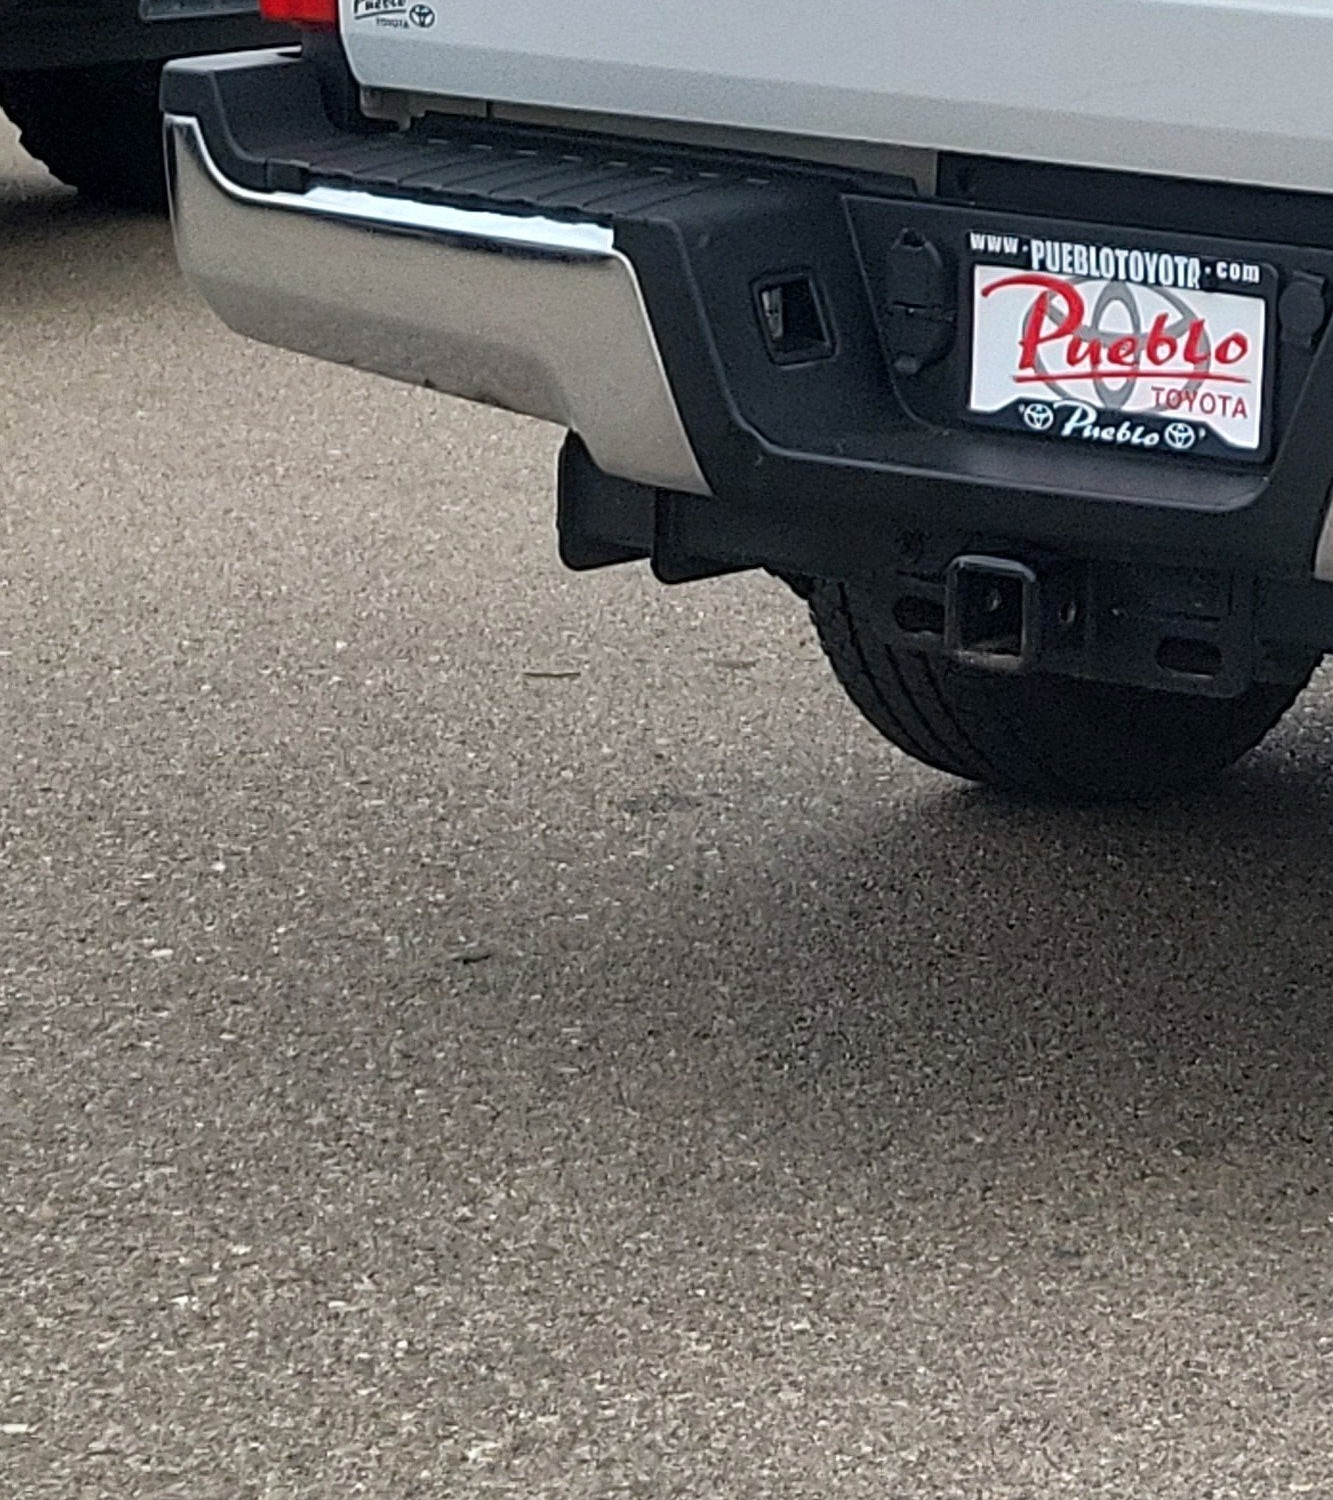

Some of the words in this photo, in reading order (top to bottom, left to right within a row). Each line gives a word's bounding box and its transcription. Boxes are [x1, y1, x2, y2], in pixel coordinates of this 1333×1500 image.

[980, 272, 1251, 370] Pueblo
[1053, 400, 1160, 446] Pueblo
[1150, 385, 1248, 420] TOYOTA
